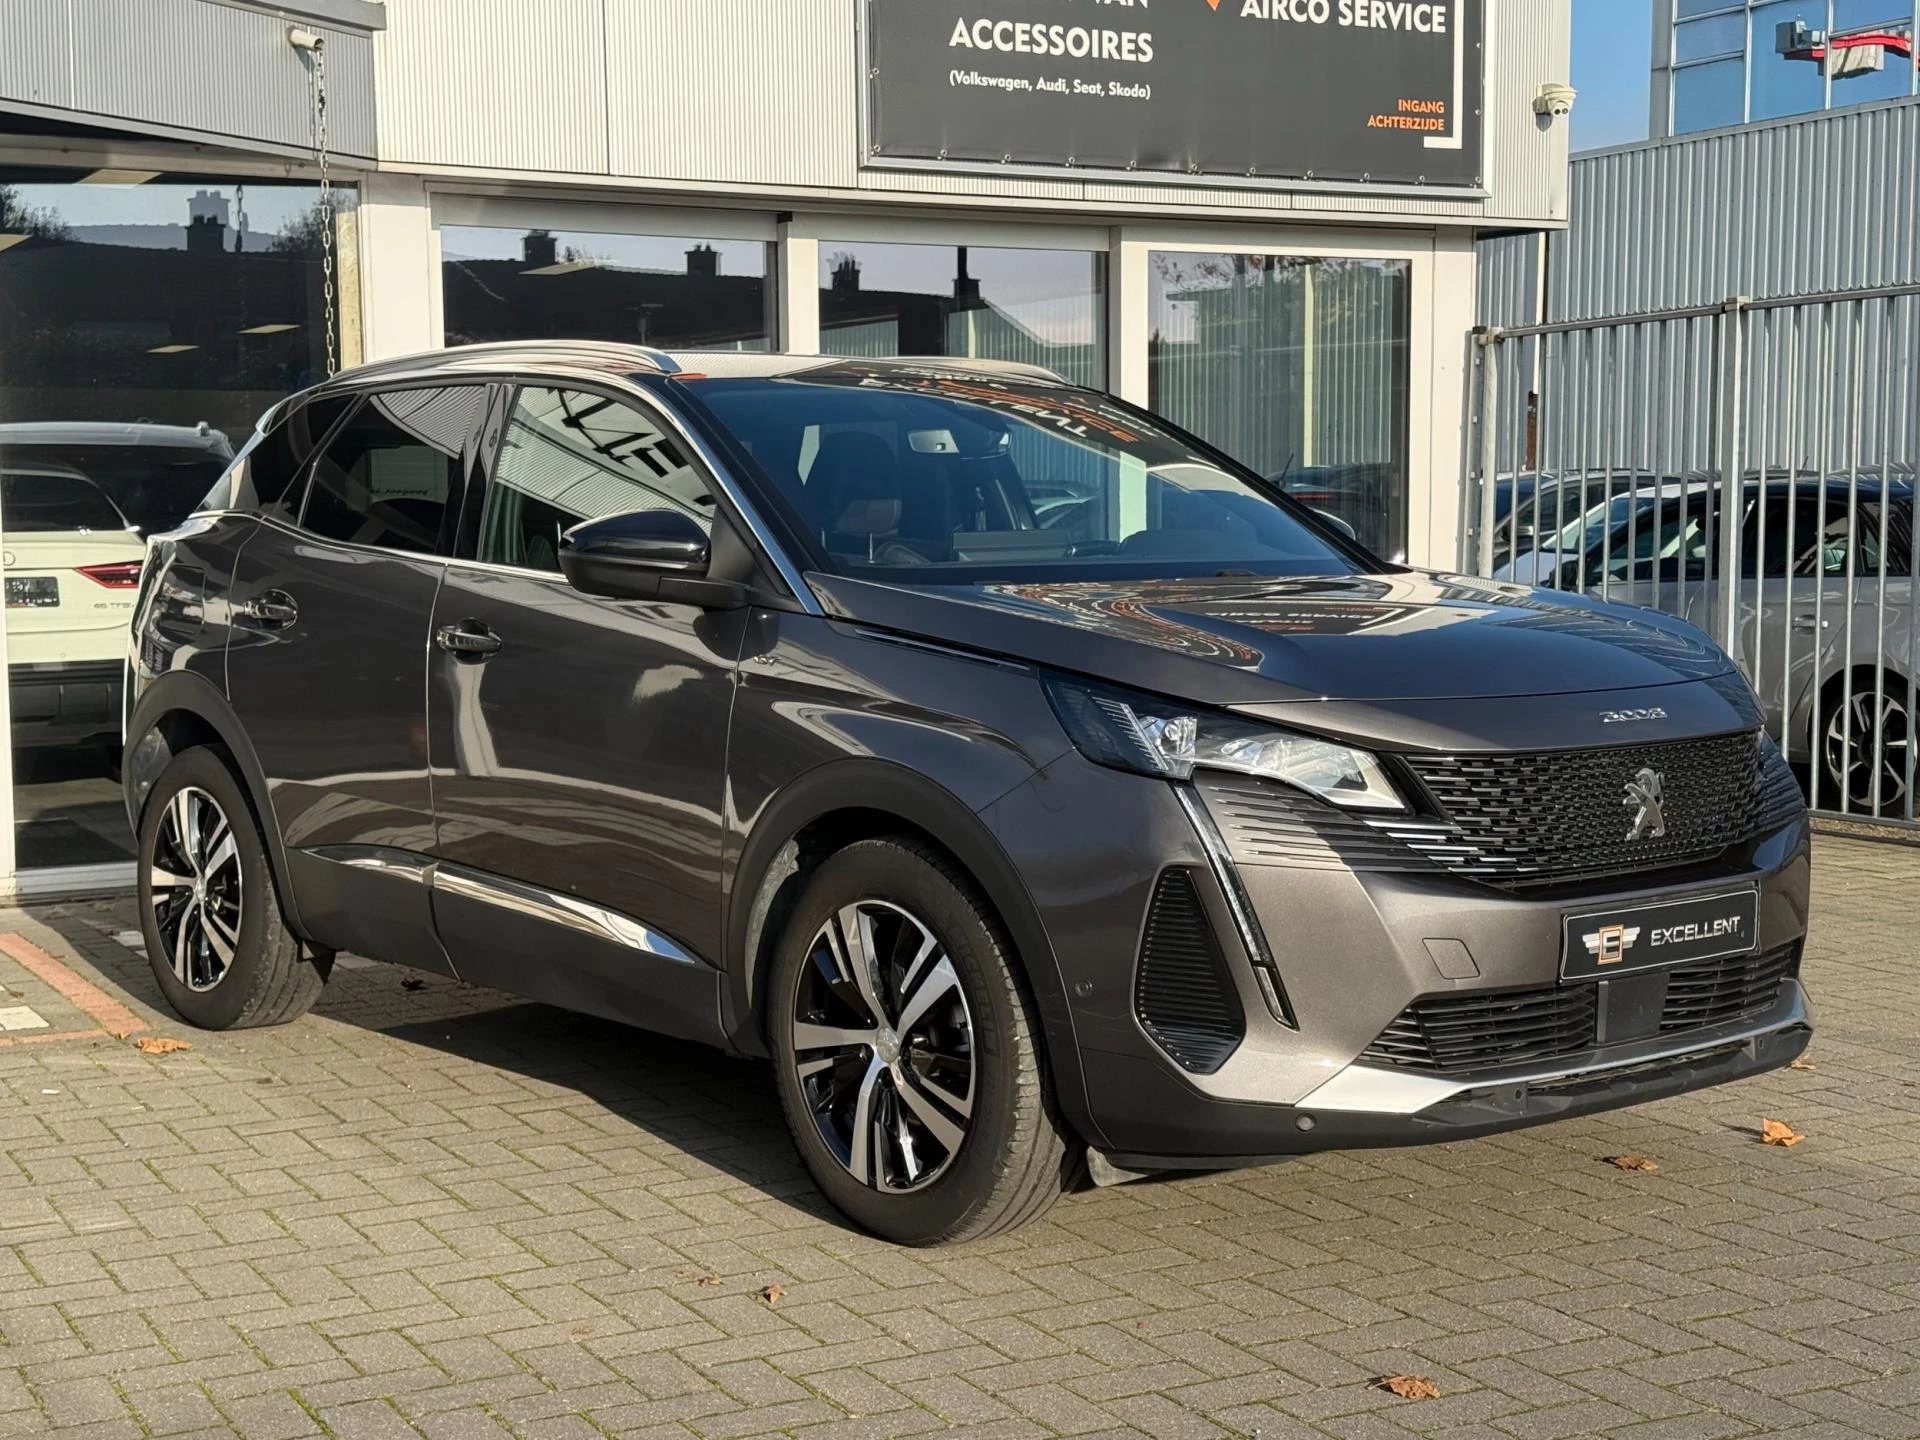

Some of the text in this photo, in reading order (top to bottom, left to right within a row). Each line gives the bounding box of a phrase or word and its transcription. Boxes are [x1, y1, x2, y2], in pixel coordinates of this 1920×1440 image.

[1240, 0, 1446, 33] AIRCO SERVICE
[949, 17, 1153, 62] ACCESSOIRES
[949, 70, 1151, 100] (Volkswagen, Audi, Seat, Skoda)
[1398, 99, 1445, 113] INGANG
[1367, 115, 1445, 131] ACHTERZIJDE
[1650, 916, 1741, 946] EXCELLENT
